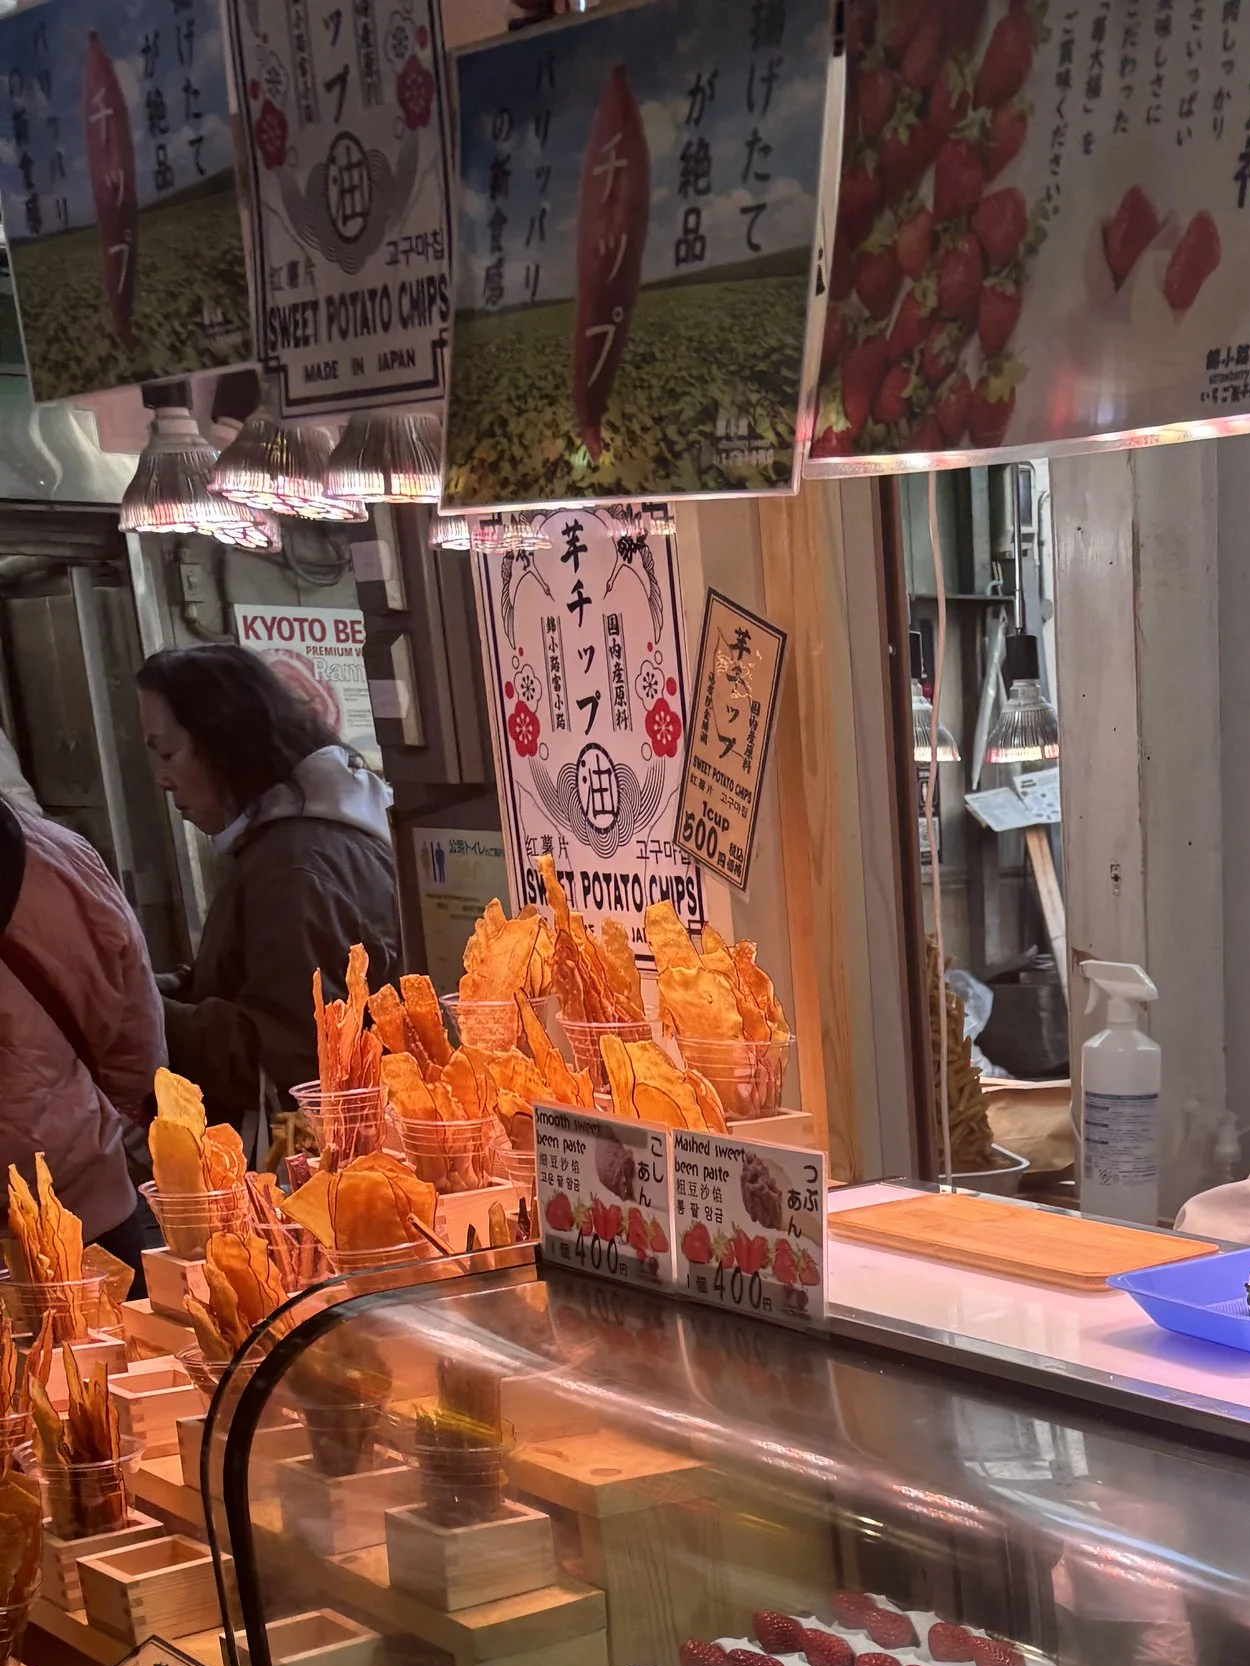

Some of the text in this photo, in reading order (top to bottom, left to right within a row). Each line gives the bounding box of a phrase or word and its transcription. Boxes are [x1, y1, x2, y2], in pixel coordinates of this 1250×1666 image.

[174, 0, 206, 177] げたて
[674, 66, 721, 271] が絶品
[585, 132, 628, 388] チップ
[267, 297, 320, 353] SWEET
[327, 283, 393, 343] POTATO
[398, 273, 450, 331] CHIPS
[303, 348, 417, 384] MADE IN JAPAN
[242, 614, 327, 643] KYOTO
[560, 518, 602, 736] 芋チップ
[305, 645, 353, 657] PREMIUM
[607, 613, 629, 731] 国内産原料
[692, 755, 753, 804] SWEET POTATO CHIPS
[525, 834, 569, 860] 红薯片
[579, 870, 644, 913] POTATO
[649, 874, 698, 916] CHIPS
[535, 1107, 571, 1130] Smooth
[536, 1129, 586, 1155] been paste
[674, 1134, 746, 1164] Mashed sweet
[674, 1156, 730, 1184] been paste
